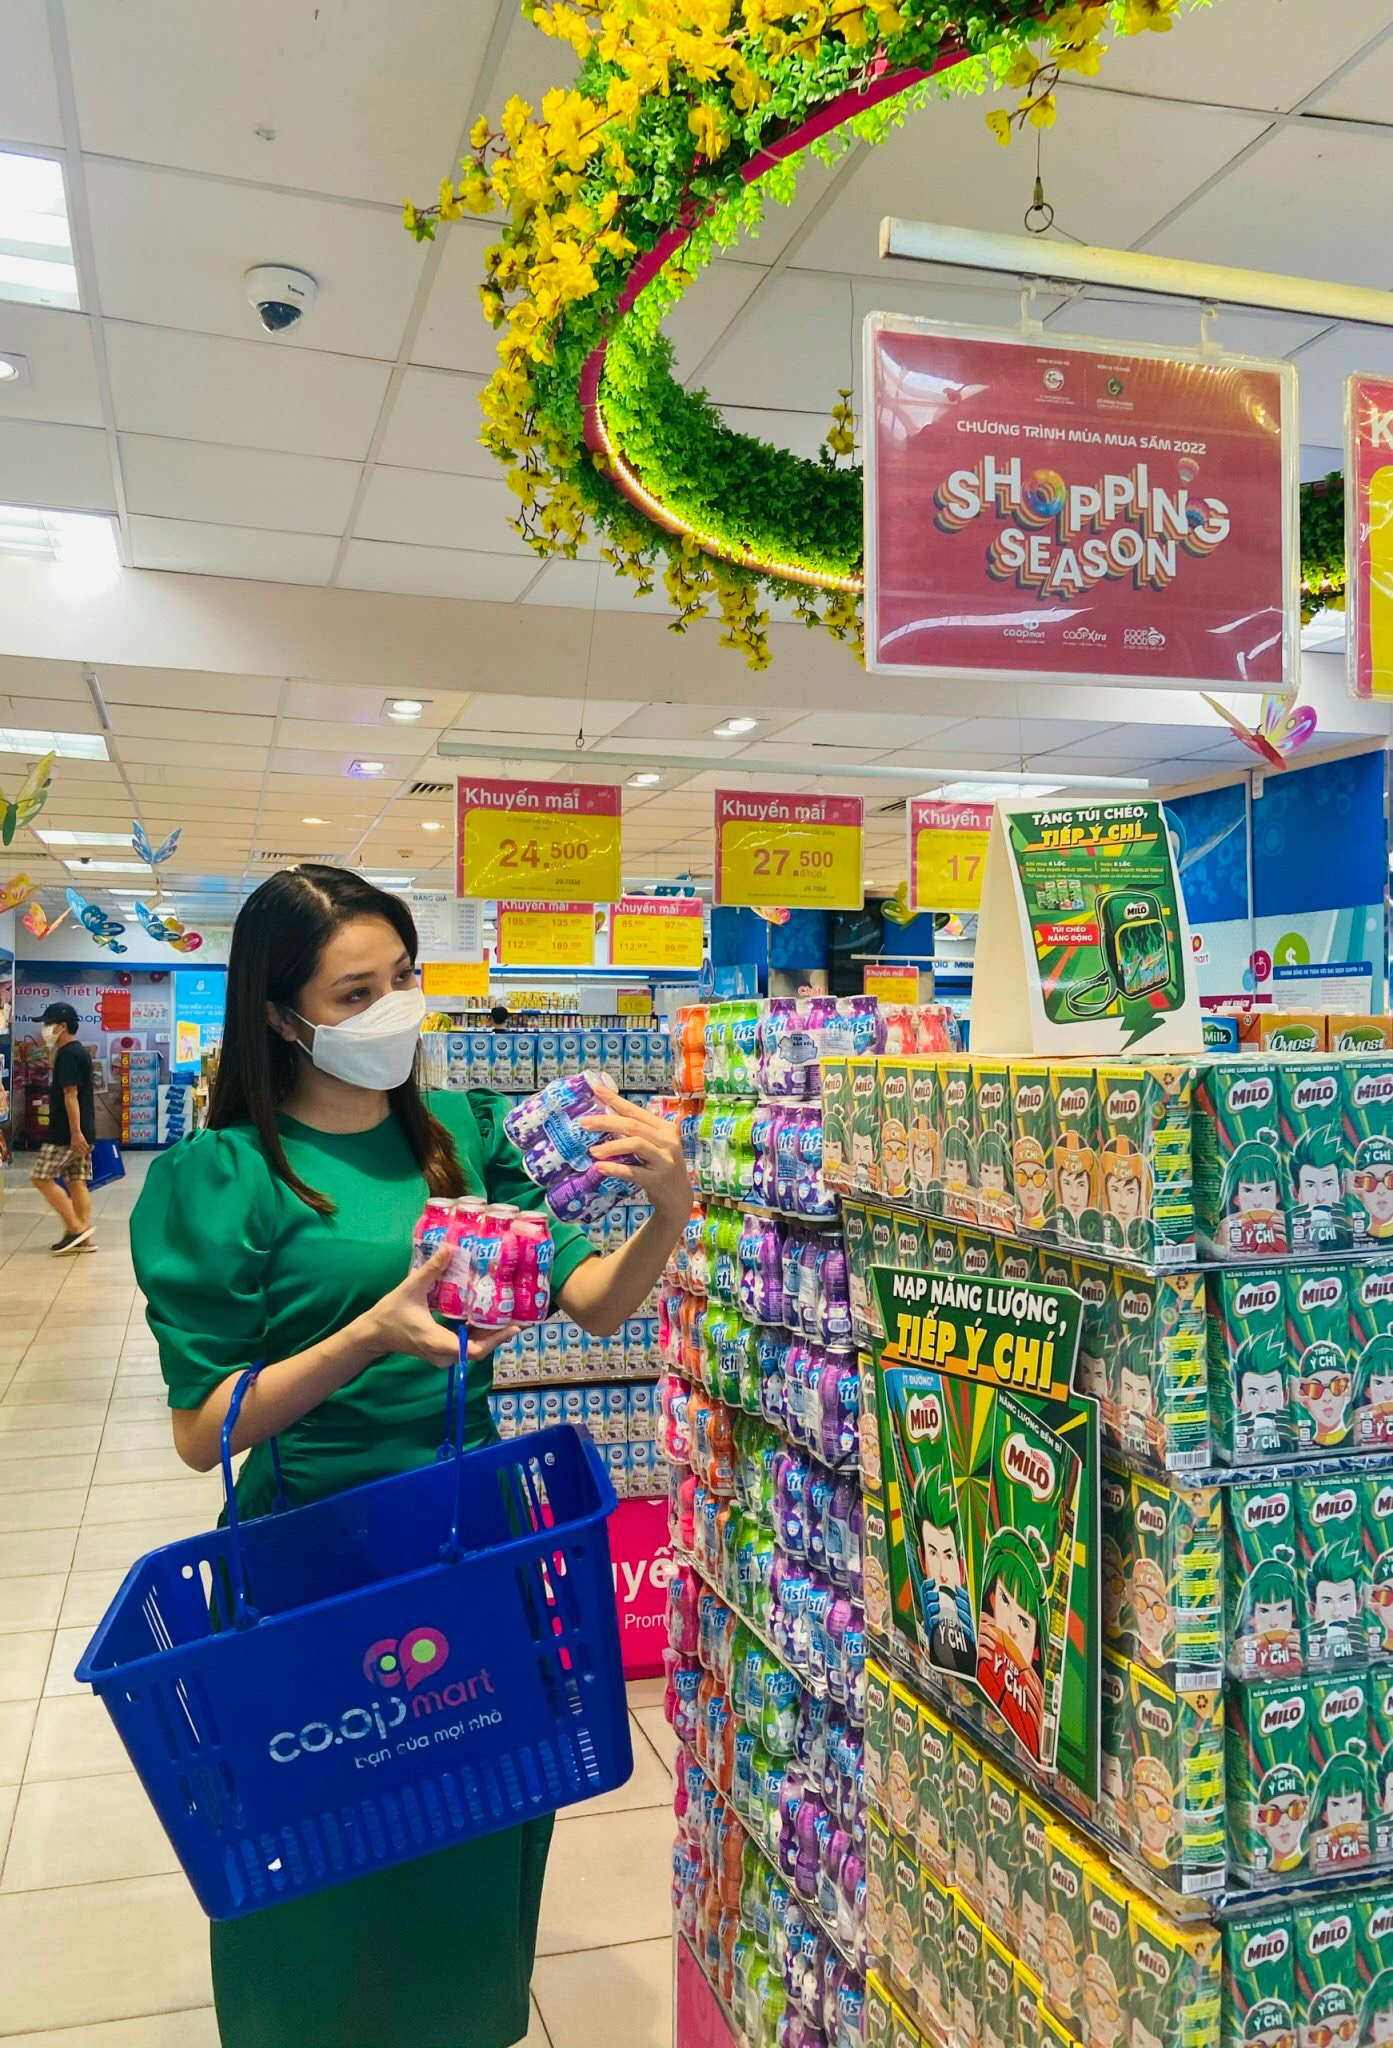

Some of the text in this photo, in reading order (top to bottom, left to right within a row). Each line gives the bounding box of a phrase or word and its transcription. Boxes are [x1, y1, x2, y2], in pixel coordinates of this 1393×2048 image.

[957, 420, 1019, 436] CHƯƠNG
[1023, 424, 1065, 440] TRÌNH
[1105, 433, 1136, 447] MUA
[1174, 441, 1206, 455] 2022
[947, 456, 1230, 543] SHOPPING
[999, 527, 1176, 588] SEASON
[465, 788, 579, 810] Khuyến mãi
[722, 799, 826, 823] Khuyến mãi
[919, 808, 980, 830] Khuyến
[1032, 804, 1148, 827] TẶNG TÚI CHÉO,
[1041, 820, 1143, 847] TIẾP Ý CHÍ
[1128, 906, 1147, 915] MILO
[65, 985, 90, 996] Tiết
[1204, 1031, 1226, 1043] Milk
[121, 1056, 129, 1065] 6
[122, 1075, 129, 1084] 6
[825, 1079, 840, 1091] MILO
[855, 1082, 872, 1093] MILO
[123, 1093, 130, 1102] 6
[886, 1083, 904, 1095] MILO
[914, 1087, 930, 1098] MILO
[947, 1088, 964, 1100] MILO
[981, 1091, 1001, 1105] MILO
[1232, 1087, 1269, 1105] MILO
[1298, 1086, 1333, 1104] MILO
[1018, 1094, 1041, 1108] MILO
[1060, 1097, 1085, 1111] MILO
[1110, 1099, 1136, 1114] MILO
[122, 1112, 129, 1120] 6
[122, 1130, 129, 1139] 6
[1364, 1148, 1391, 1163] Ý CHÍ
[1245, 1229, 1254, 1244] Ý
[1256, 1227, 1275, 1244] CHÍ
[935, 1247, 952, 1259] MILO
[966, 1255, 987, 1268] MILO
[1004, 1265, 1026, 1279] MILO
[1082, 1286, 1104, 1302] MILO
[1239, 1290, 1276, 1309] MILO
[1302, 1286, 1337, 1305] MILO
[893, 1274, 1067, 1337] NẠP NĂNG LƯỢNG,
[1123, 1301, 1148, 1316] MILO
[897, 1307, 1055, 1390] TIẾP Ý CHÍ
[1310, 1353, 1337, 1368] Ý CHÍ
[911, 1408, 938, 1431] MILO
[999, 1394, 1016, 1414] NĂNG
[1017, 1409, 1039, 1434] LƯỢNG
[1008, 1444, 1049, 1490] MILO
[1247, 1502, 1286, 1523] MILO
[1316, 1499, 1353, 1518] MILO
[1139, 1511, 1164, 1530] MILO
[948, 1628, 967, 1653] CHÍ
[868, 1691, 883, 1707] MILO
[1005, 1670, 1026, 1712] CHÍ
[1324, 1696, 1360, 1716] MILO
[895, 1715, 910, 1732] MILO
[1142, 1711, 1169, 1733] MILO
[1264, 1707, 1301, 1728] MILO
[397, 1734, 430, 1754] của
[434, 1721, 465, 1741] mọi
[923, 1741, 941, 1759] MILO
[959, 1771, 975, 1789] MILO
[1269, 1777, 1296, 1795] Ý CHÍ
[990, 1802, 1009, 1818] MILO
[1052, 1869, 1074, 1892] MILO
[1092, 1908, 1117, 1933] MILO
[1312, 1926, 1347, 1948] MILO
[1247, 1939, 1285, 1963] MILO
[1138, 1951, 1166, 1978] MILO
[1318, 1999, 1346, 2016] Ý CHÍ
[1253, 2013, 1283, 2032] Ý CHÍ
